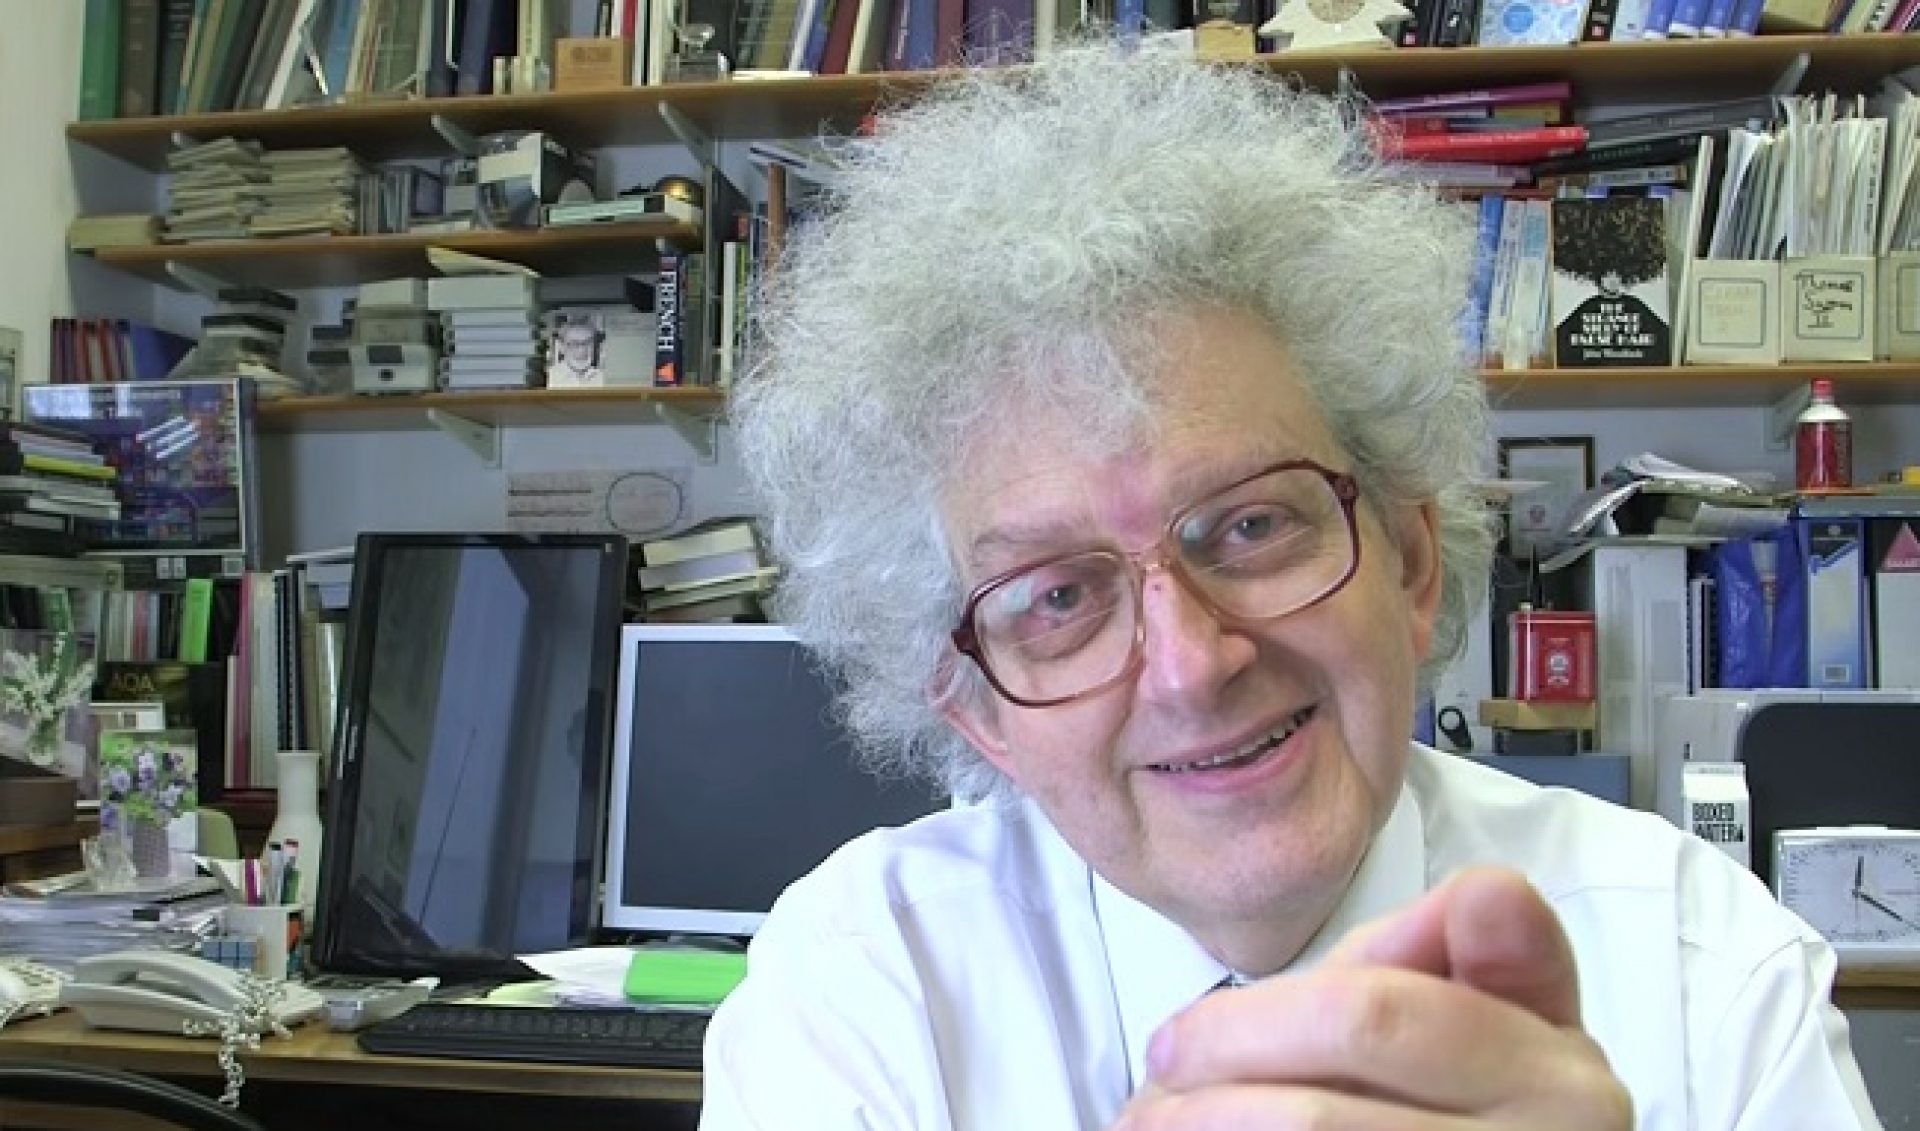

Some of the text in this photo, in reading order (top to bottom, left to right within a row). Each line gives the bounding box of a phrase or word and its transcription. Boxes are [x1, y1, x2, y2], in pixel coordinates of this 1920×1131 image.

[659, 271, 677, 352] FRENCH
[111, 671, 155, 692] AQA
[1692, 803, 1735, 821] BOXED
